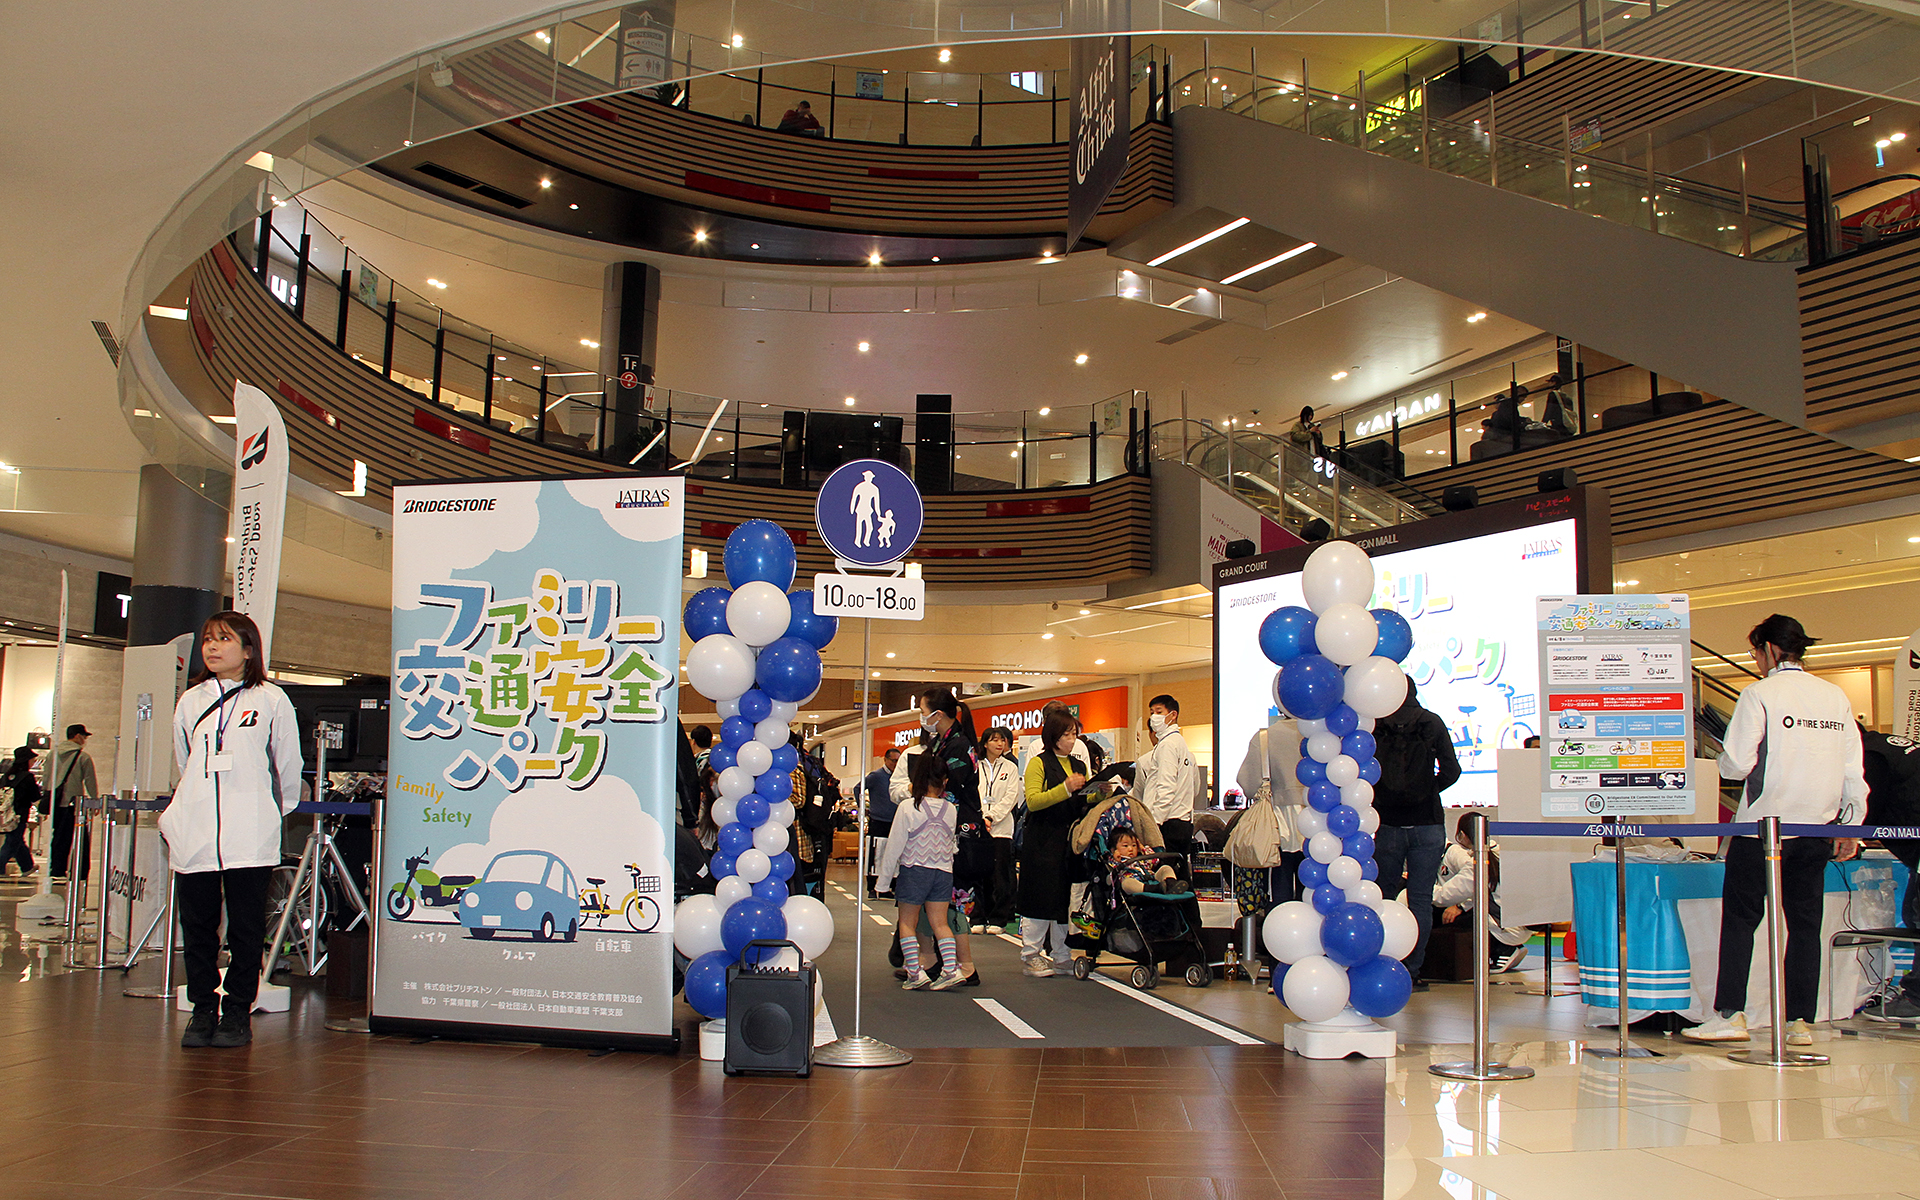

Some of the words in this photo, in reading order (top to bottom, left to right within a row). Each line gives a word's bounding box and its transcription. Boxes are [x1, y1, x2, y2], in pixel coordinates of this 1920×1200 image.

[1076, 98, 1116, 186] Chiba
[615, 488, 671, 504] JATRAS
[402, 498, 497, 513] BRIDGESTONE
[1375, 534, 1399, 547] MALL
[1521, 537, 1562, 555] JATRAS
[1219, 565, 1243, 579] GRAND
[1244, 560, 1268, 573] COURT
[1230, 592, 1277, 608] BRIDGESTONE
[419, 569, 665, 650] ファミリー
[1567, 602, 1613, 617] ファミリー
[1548, 614, 1624, 633] 交通安全パーク
[394, 636, 674, 741] 交通安全
[991, 711, 1023, 731] DECO
[1797, 718, 1818, 729] #TIRE
[1820, 720, 1845, 731] SAFETY
[443, 726, 608, 793] パーク
[395, 775, 445, 804] Family
[422, 807, 472, 827] Safety
[1615, 825, 1646, 836] MALL
[1897, 827, 1920, 838] MALL
[412, 931, 447, 943] バイク
[595, 939, 632, 953] 自転車
[502, 948, 536, 961] クルマ
[402, 981, 417, 990] 主催
[424, 982, 493, 994] 株式会社ブリヂストン
[504, 987, 549, 998] 一般財団法人
[552, 990, 643, 1004] 日本交通安全教育普及協会
[421, 996, 436, 1005] 協力
[443, 997, 479, 1008] 千葉県警察
[490, 1001, 535, 1012] 一般社団法人
[538, 1003, 590, 1015] 日本自動車連盟
[592, 1006, 623, 1017] 千葉支部
